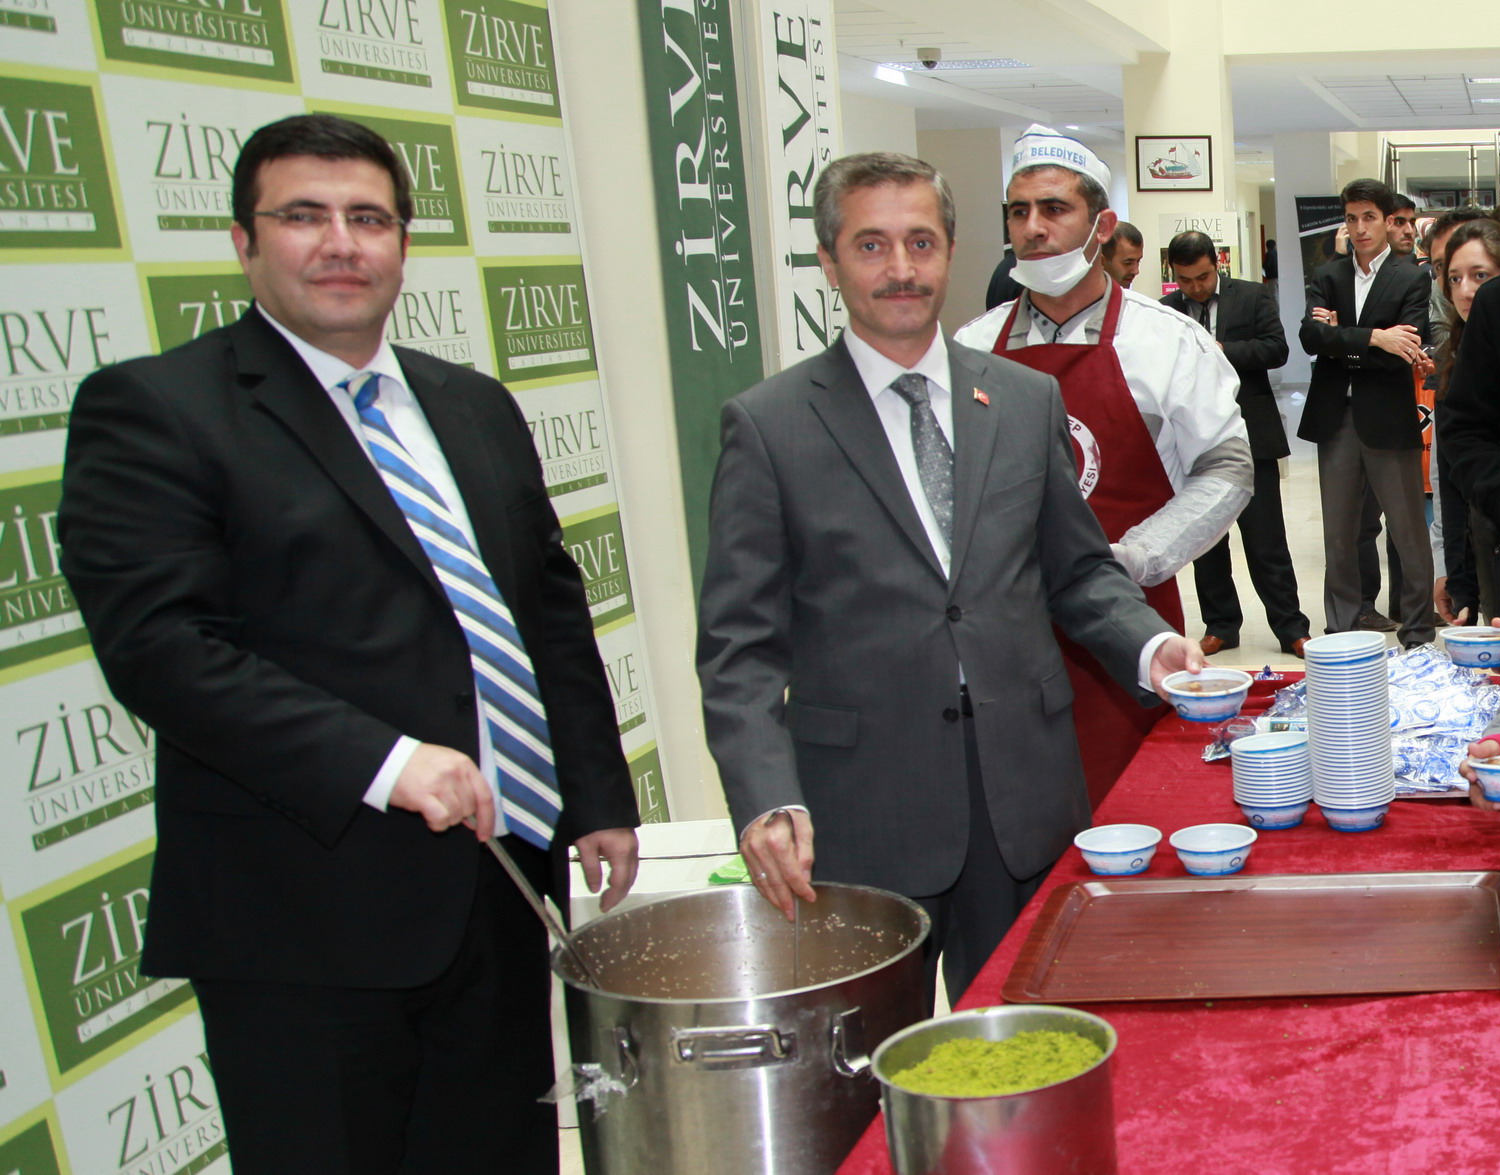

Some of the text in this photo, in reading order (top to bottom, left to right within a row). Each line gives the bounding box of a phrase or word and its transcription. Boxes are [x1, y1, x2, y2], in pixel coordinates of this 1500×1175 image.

[461, 6, 547, 68] ZİRVE
[0, 180, 88, 209] SİTESİ
[481, 144, 563, 197] ZİRVE
[661, 0, 727, 352] ZİRV
[702, 0, 749, 349] ÜNİVERSİTES
[1174, 217, 1222, 233] ZİRVE
[502, 279, 582, 330] ZİRVE
[0, 307, 117, 376] RVE
[546, 453, 605, 482] İVERSİTESİ
[563, 532, 619, 580] RVE
[17, 702, 150, 792] ZİRV
[30, 757, 156, 826] ÜNİVERSİ
